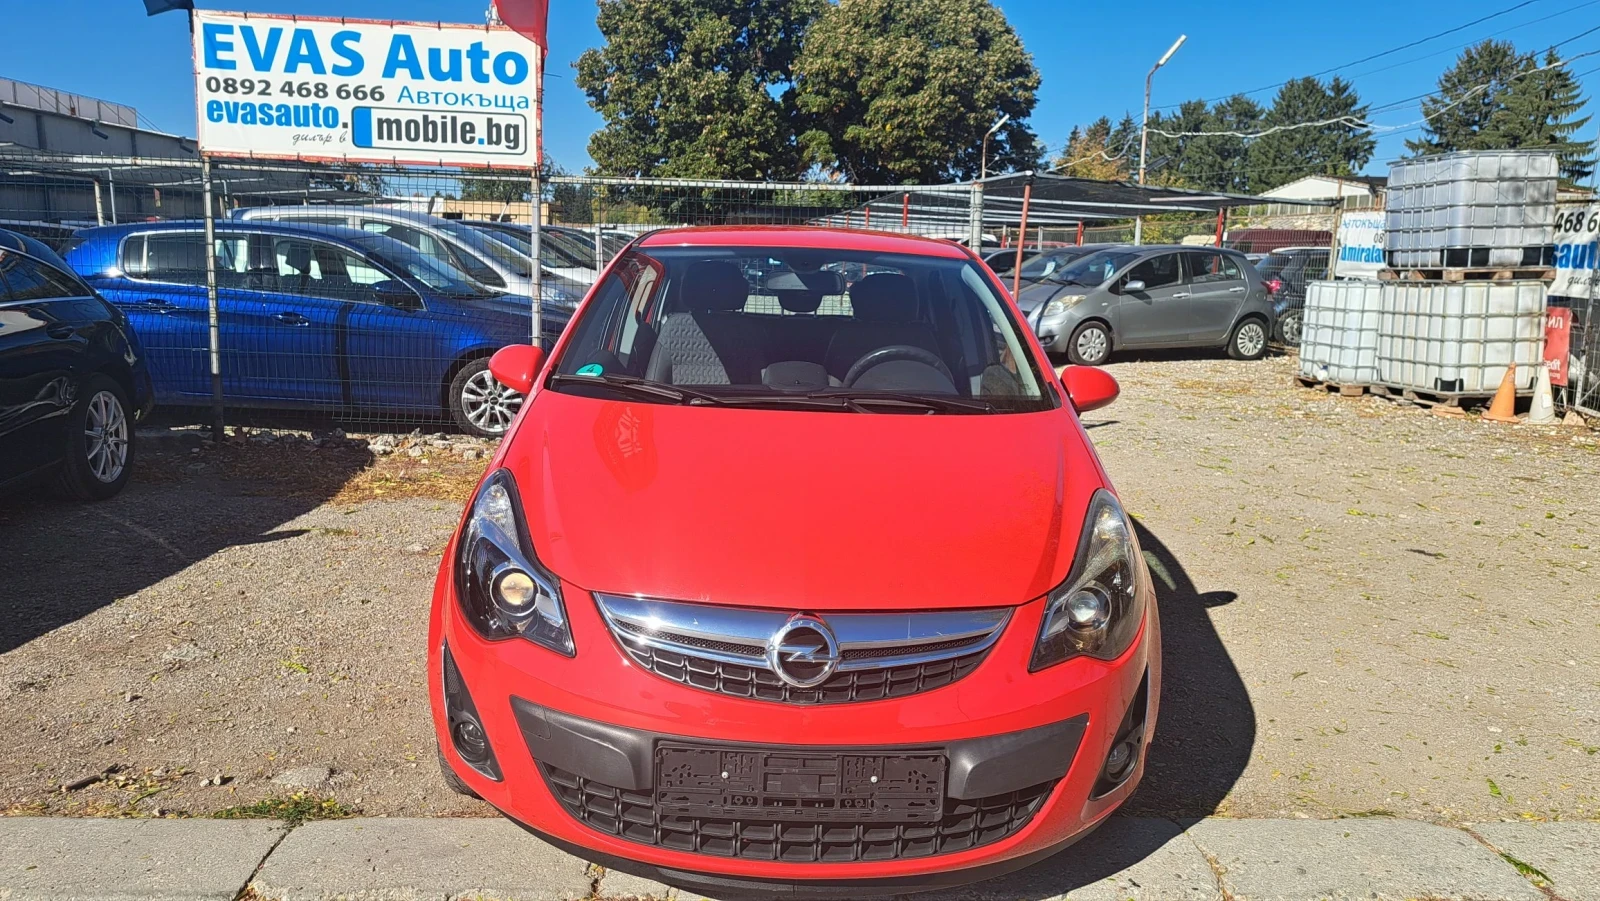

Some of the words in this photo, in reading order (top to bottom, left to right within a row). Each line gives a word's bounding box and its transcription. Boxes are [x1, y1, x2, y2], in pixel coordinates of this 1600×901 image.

[202, 22, 365, 76] EVAS
[382, 33, 529, 86] Auto
[205, 76, 272, 96] 0892
[279, 80, 329, 99] 468
[336, 84, 385, 102] 666
[396, 85, 529, 112] Автокъща
[292, 131, 333, 146] дилър
[377, 114, 519, 150] mobile.bg
[1555, 211, 1585, 233] 468
[1587, 211, 1600, 233] 6
